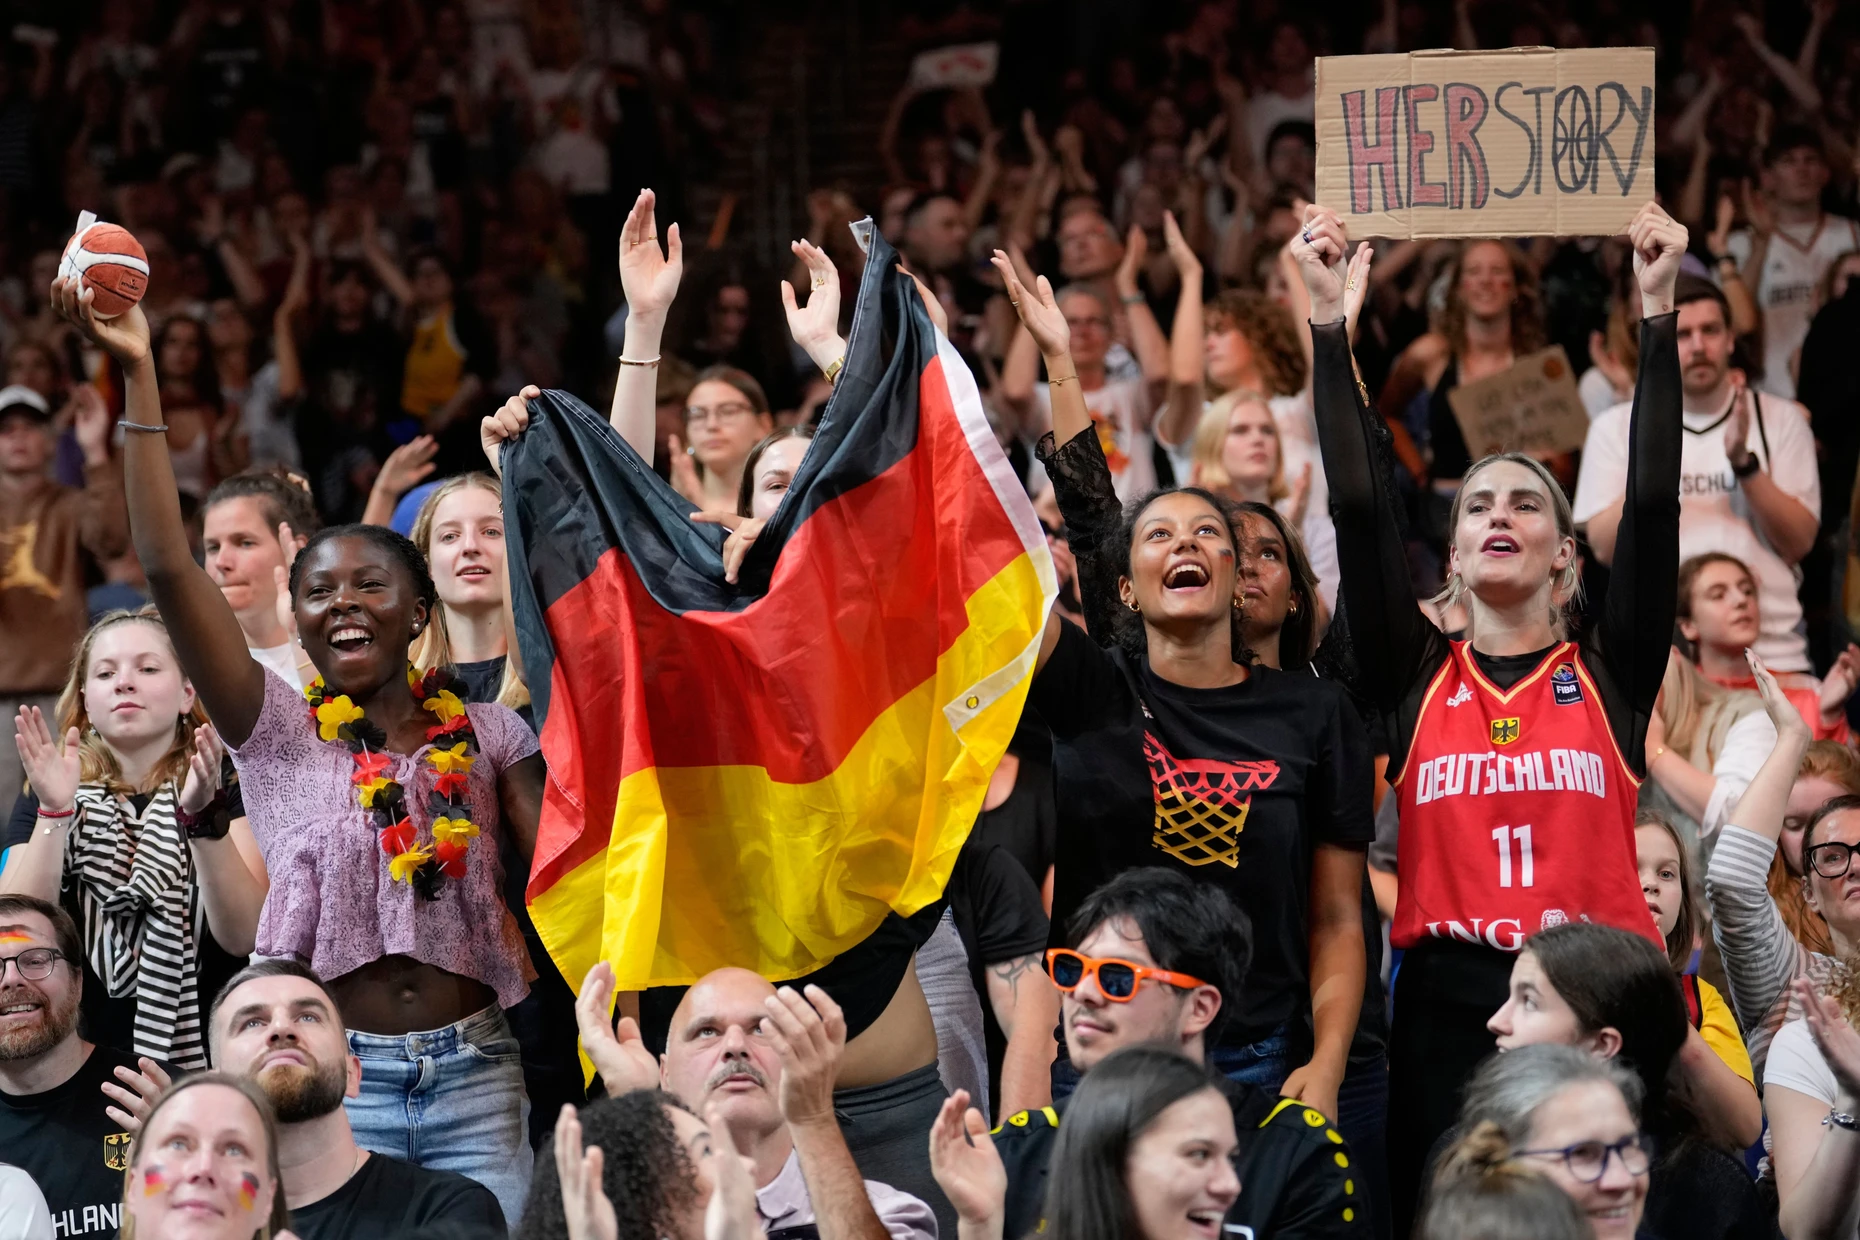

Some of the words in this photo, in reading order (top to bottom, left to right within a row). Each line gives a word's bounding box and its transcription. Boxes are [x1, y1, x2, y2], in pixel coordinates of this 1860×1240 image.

[1556, 684, 1577, 695] FIBA
[1416, 749, 1606, 806] DEUTSCHLAND
[1491, 824, 1534, 888] 11
[1425, 918, 1526, 951] ING
